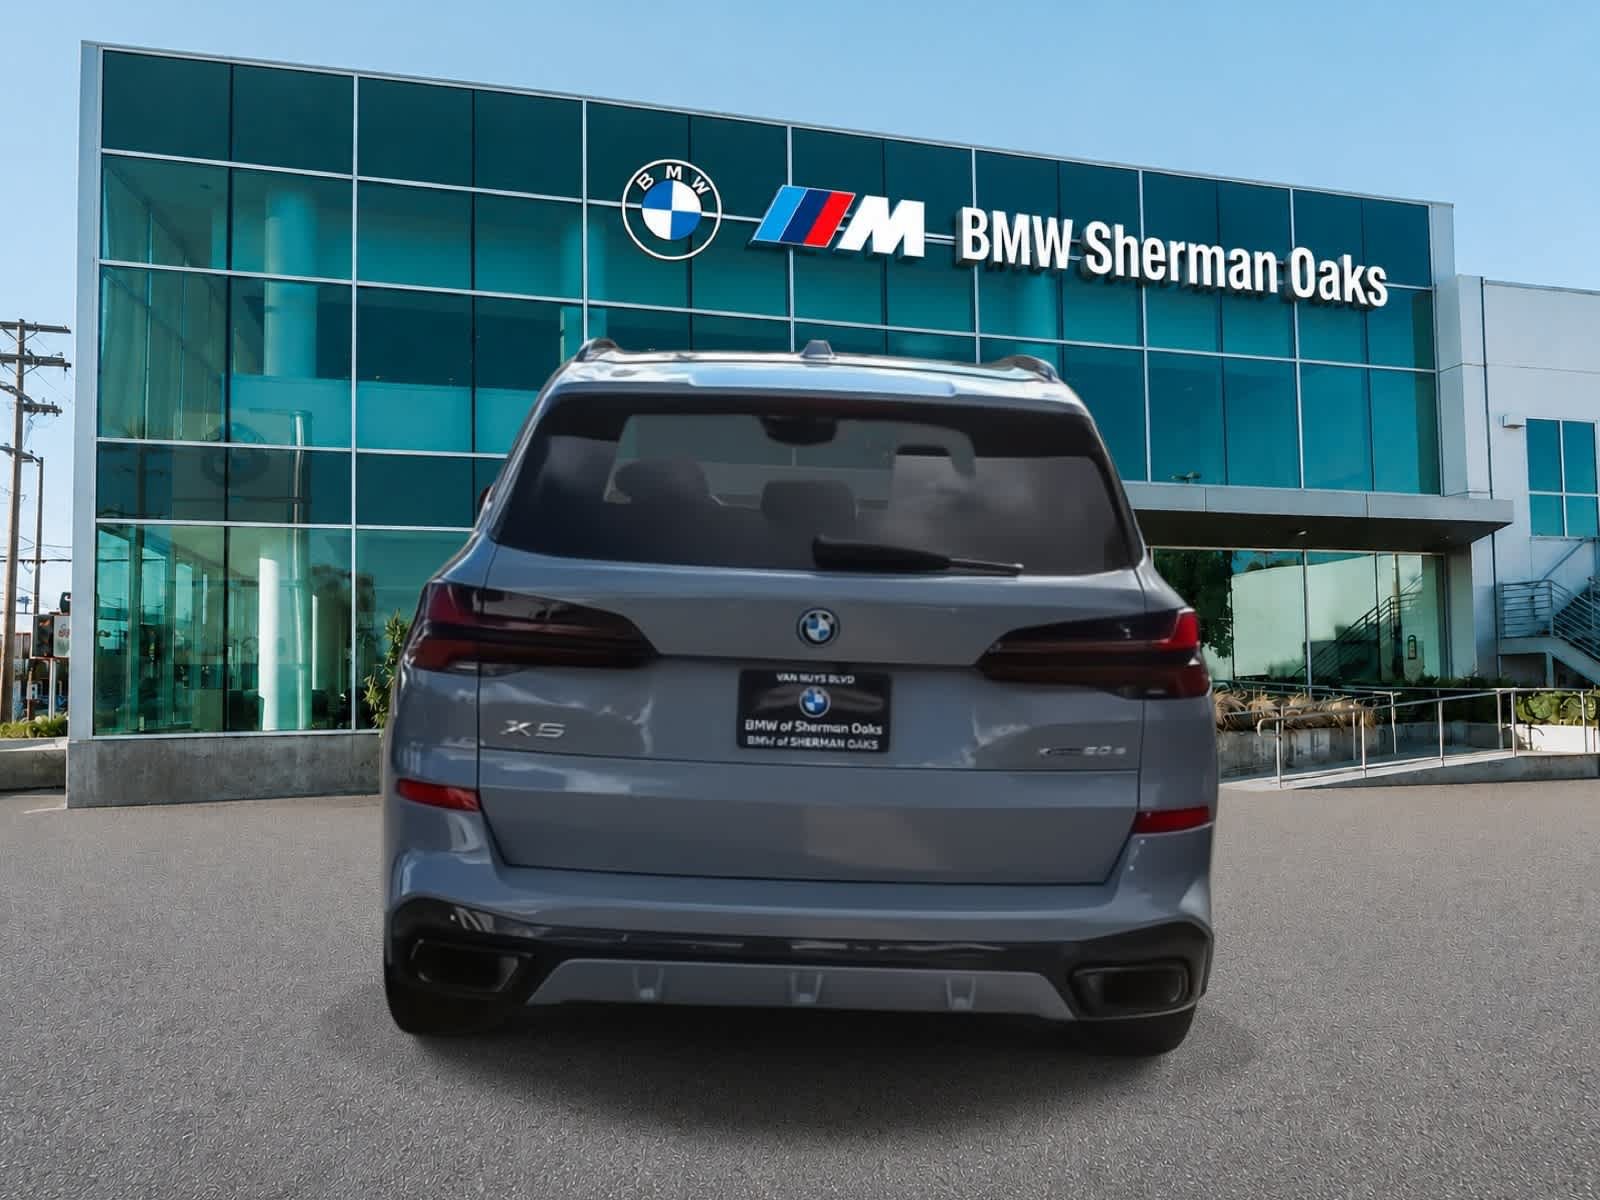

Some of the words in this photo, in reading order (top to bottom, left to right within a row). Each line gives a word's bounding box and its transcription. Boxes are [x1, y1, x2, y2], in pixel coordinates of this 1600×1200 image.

[636, 164, 711, 195] BMW
[961, 206, 1073, 270] BMW
[1085, 220, 1277, 293] Sherman
[1289, 247, 1389, 308] Oaks
[776, 672, 797, 682] VAN
[828, 674, 855, 684] BLVD
[499, 719, 566, 738] X5
[744, 719, 778, 731] BMW
[779, 720, 792, 732] of
[794, 720, 849, 734] Sherman
[851, 722, 883, 735] Oaks
[747, 735, 775, 745] BMW
[777, 736, 788, 746] of
[790, 736, 845, 748] SHERMAN
[847, 739, 879, 750] OAKS
